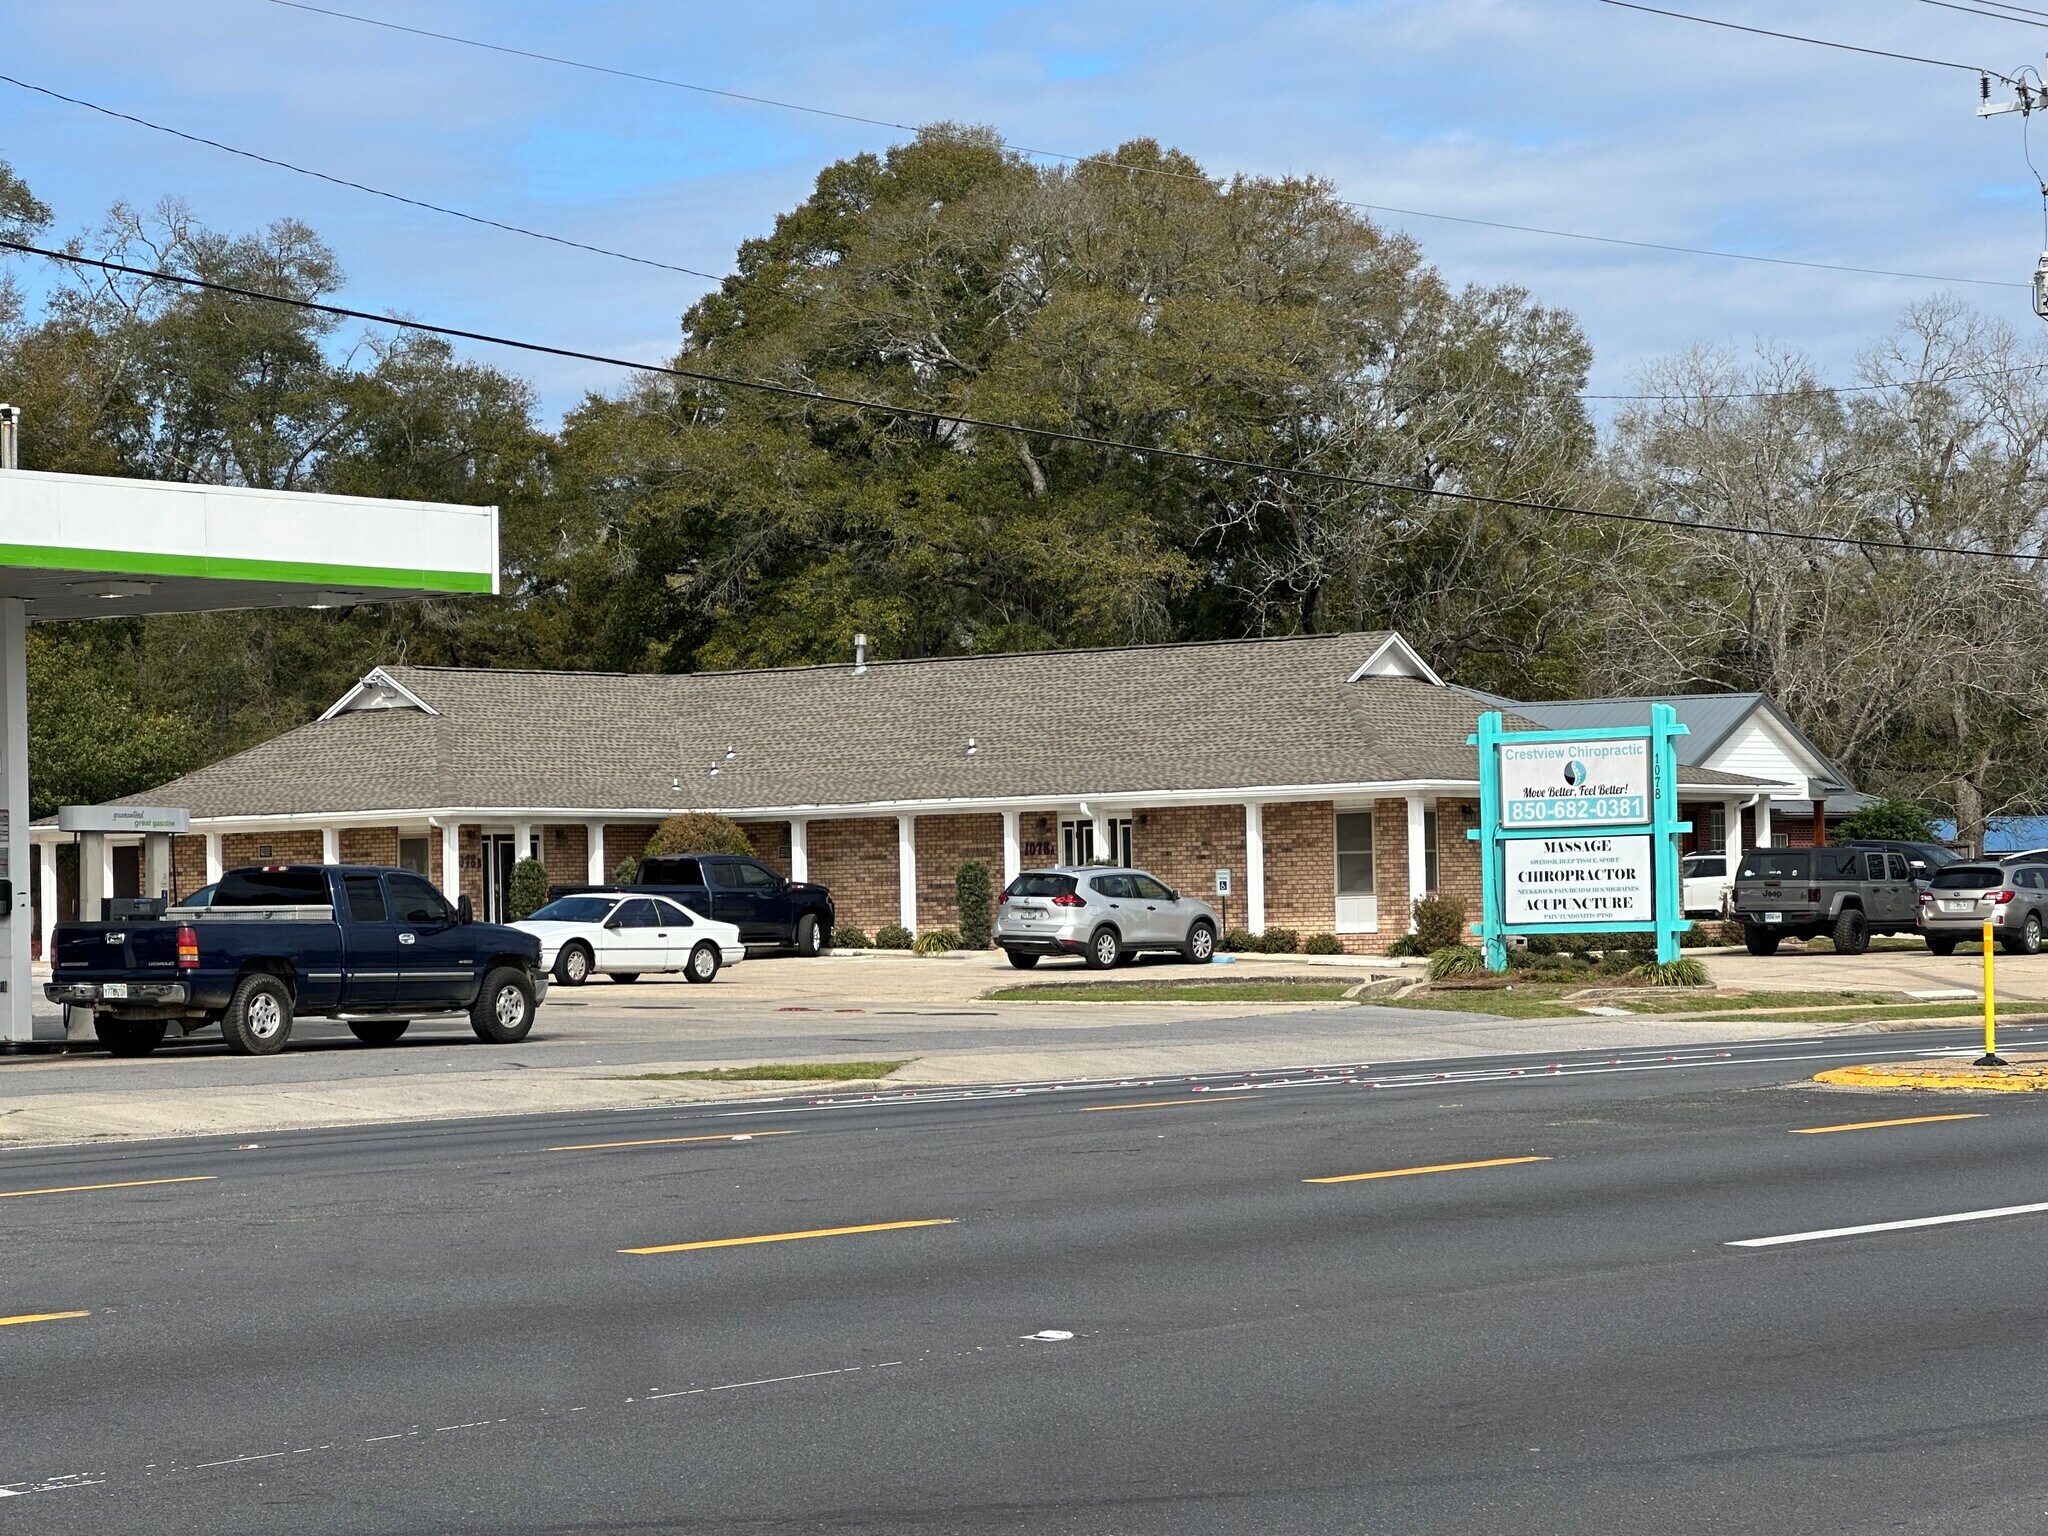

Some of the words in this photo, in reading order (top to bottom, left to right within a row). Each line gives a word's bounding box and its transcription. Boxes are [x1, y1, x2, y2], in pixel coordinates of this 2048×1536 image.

[1505, 747, 1565, 760] Crestview
[1568, 743, 1644, 759] Chiropractic
[1523, 786, 1546, 799] Move
[1547, 785, 1577, 798] Better,
[1578, 784, 1597, 796] Feel
[1597, 783, 1629, 796] Better!
[1512, 798, 1640, 820] 850-682-0381
[134, 819, 151, 828] great
[152, 820, 175, 828] gasoline
[1543, 839, 1612, 854] MASSAGE
[1517, 867, 1637, 884] CHIROPRACTOR
[1762, 889, 1782, 898] Jeep
[1524, 896, 1634, 912] ACUPUNCTURE
